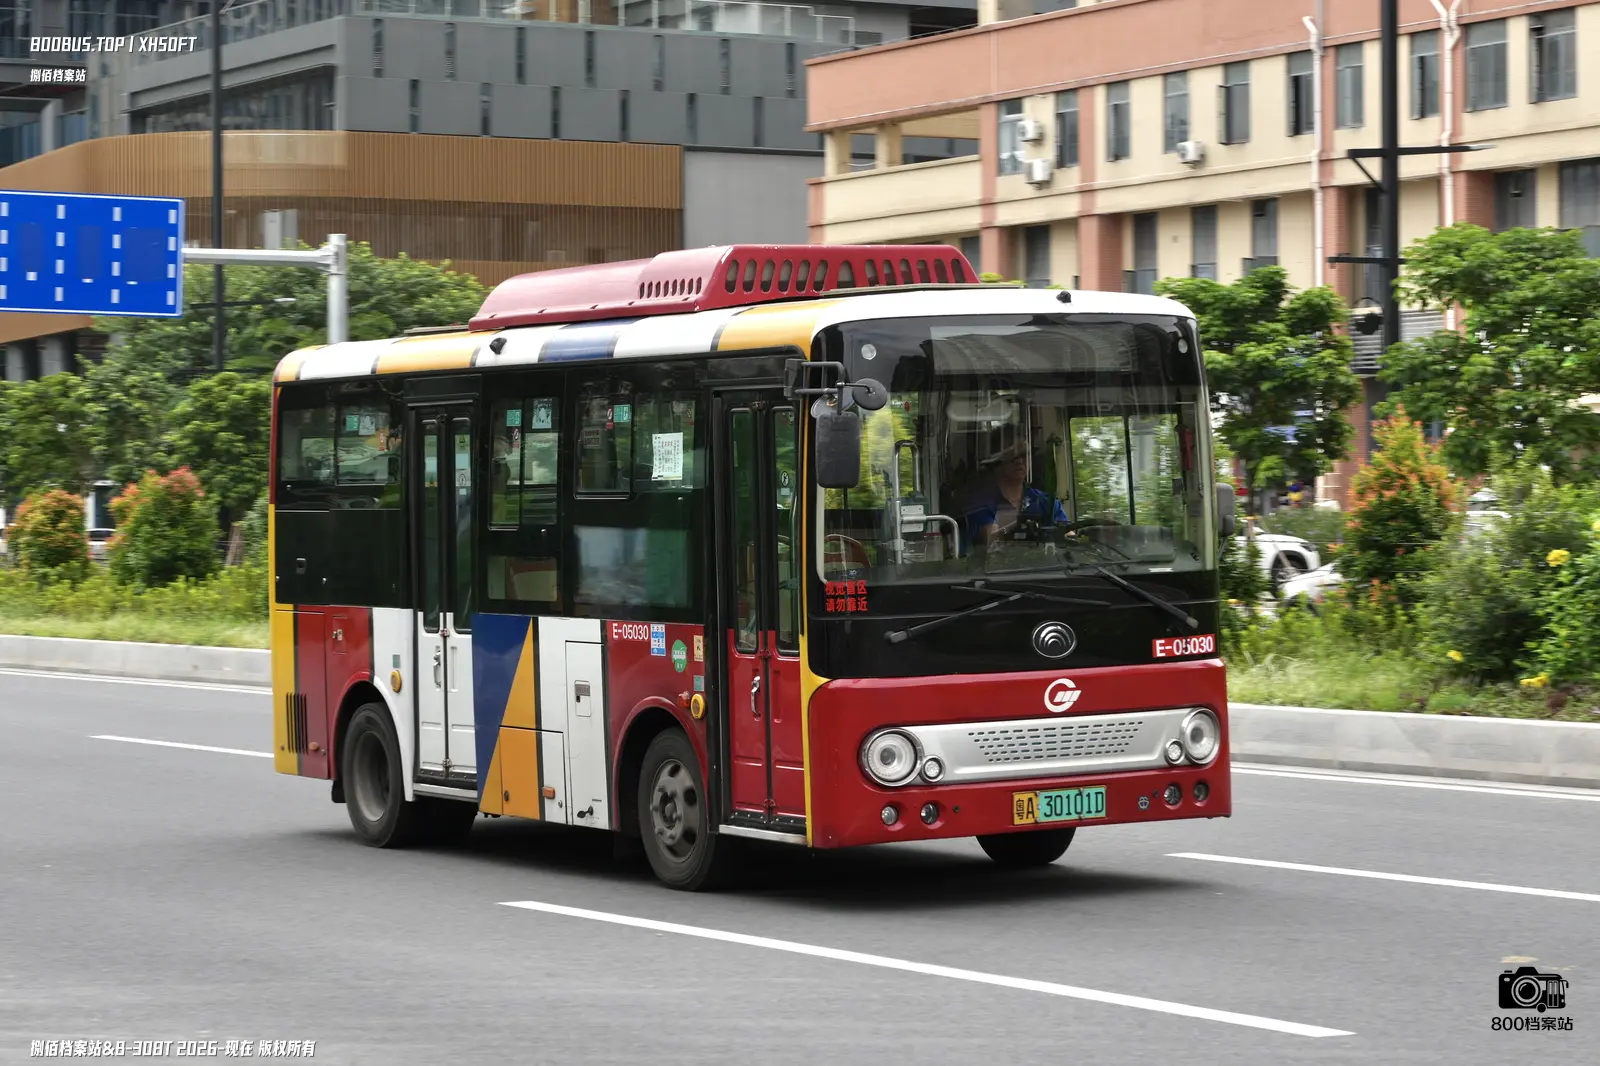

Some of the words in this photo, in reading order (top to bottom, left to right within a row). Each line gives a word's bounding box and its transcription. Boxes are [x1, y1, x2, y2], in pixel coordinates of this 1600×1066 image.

[825, 580, 867, 595] 视觉盲区
[826, 597, 868, 612] 请勿靠近
[612, 623, 649, 640] E-05030
[1155, 636, 1214, 657] E-05030
